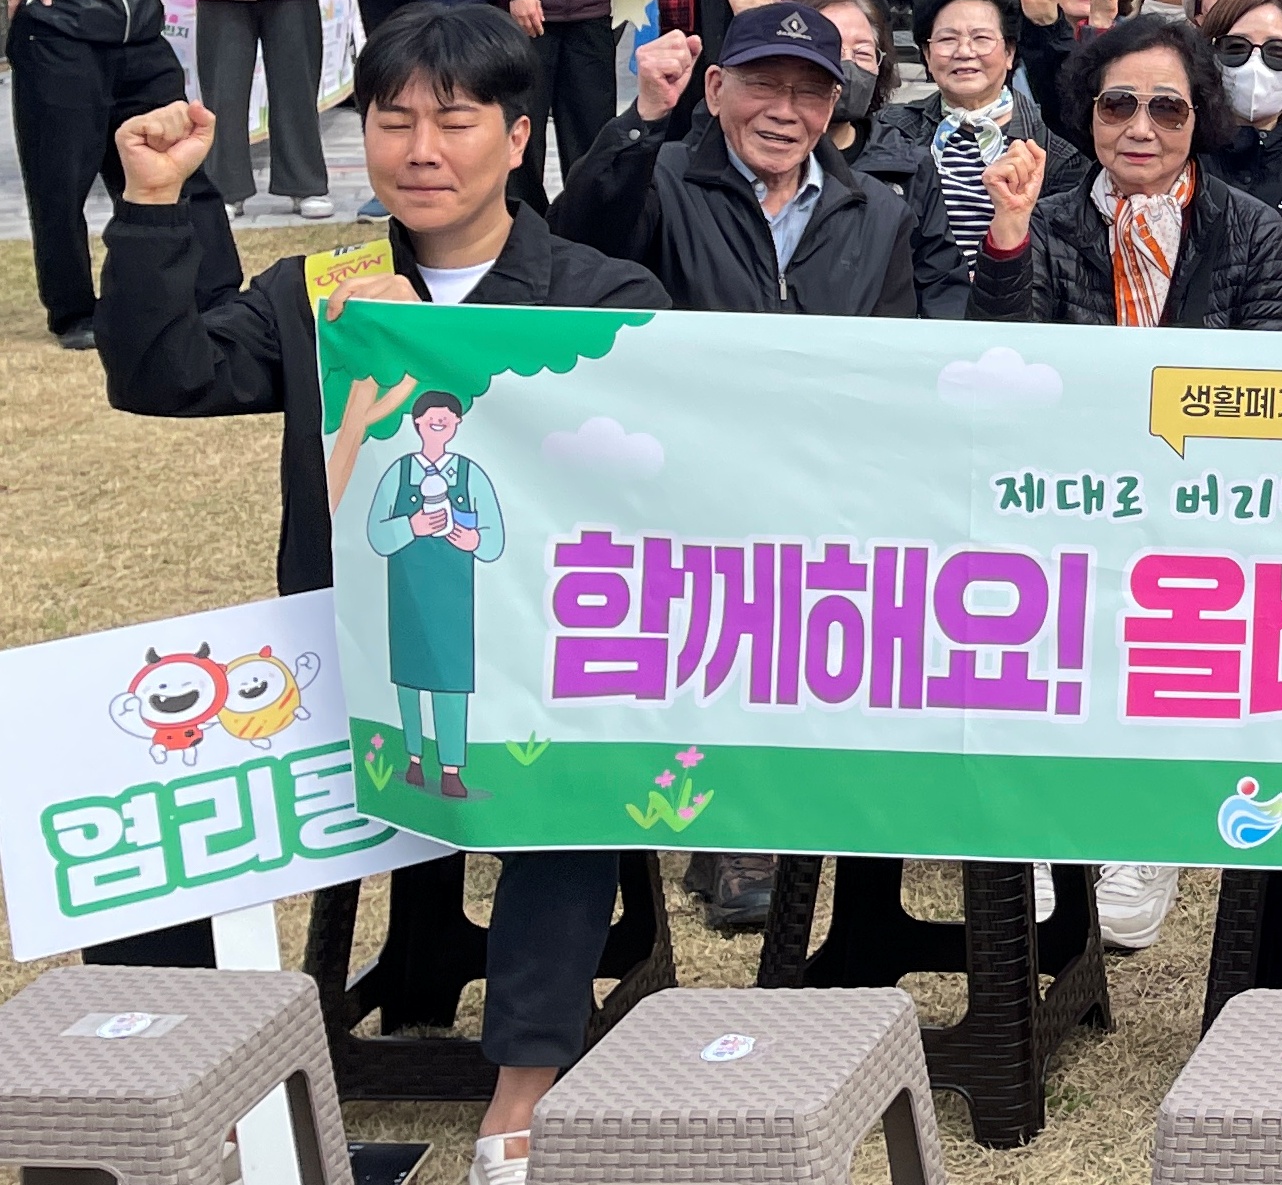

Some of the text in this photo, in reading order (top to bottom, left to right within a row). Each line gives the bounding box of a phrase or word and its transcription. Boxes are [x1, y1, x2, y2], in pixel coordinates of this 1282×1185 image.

[995, 472, 1142, 518] 제대로
[551, 530, 1089, 716] 함께해요!
[41, 742, 399, 917] 염리동
